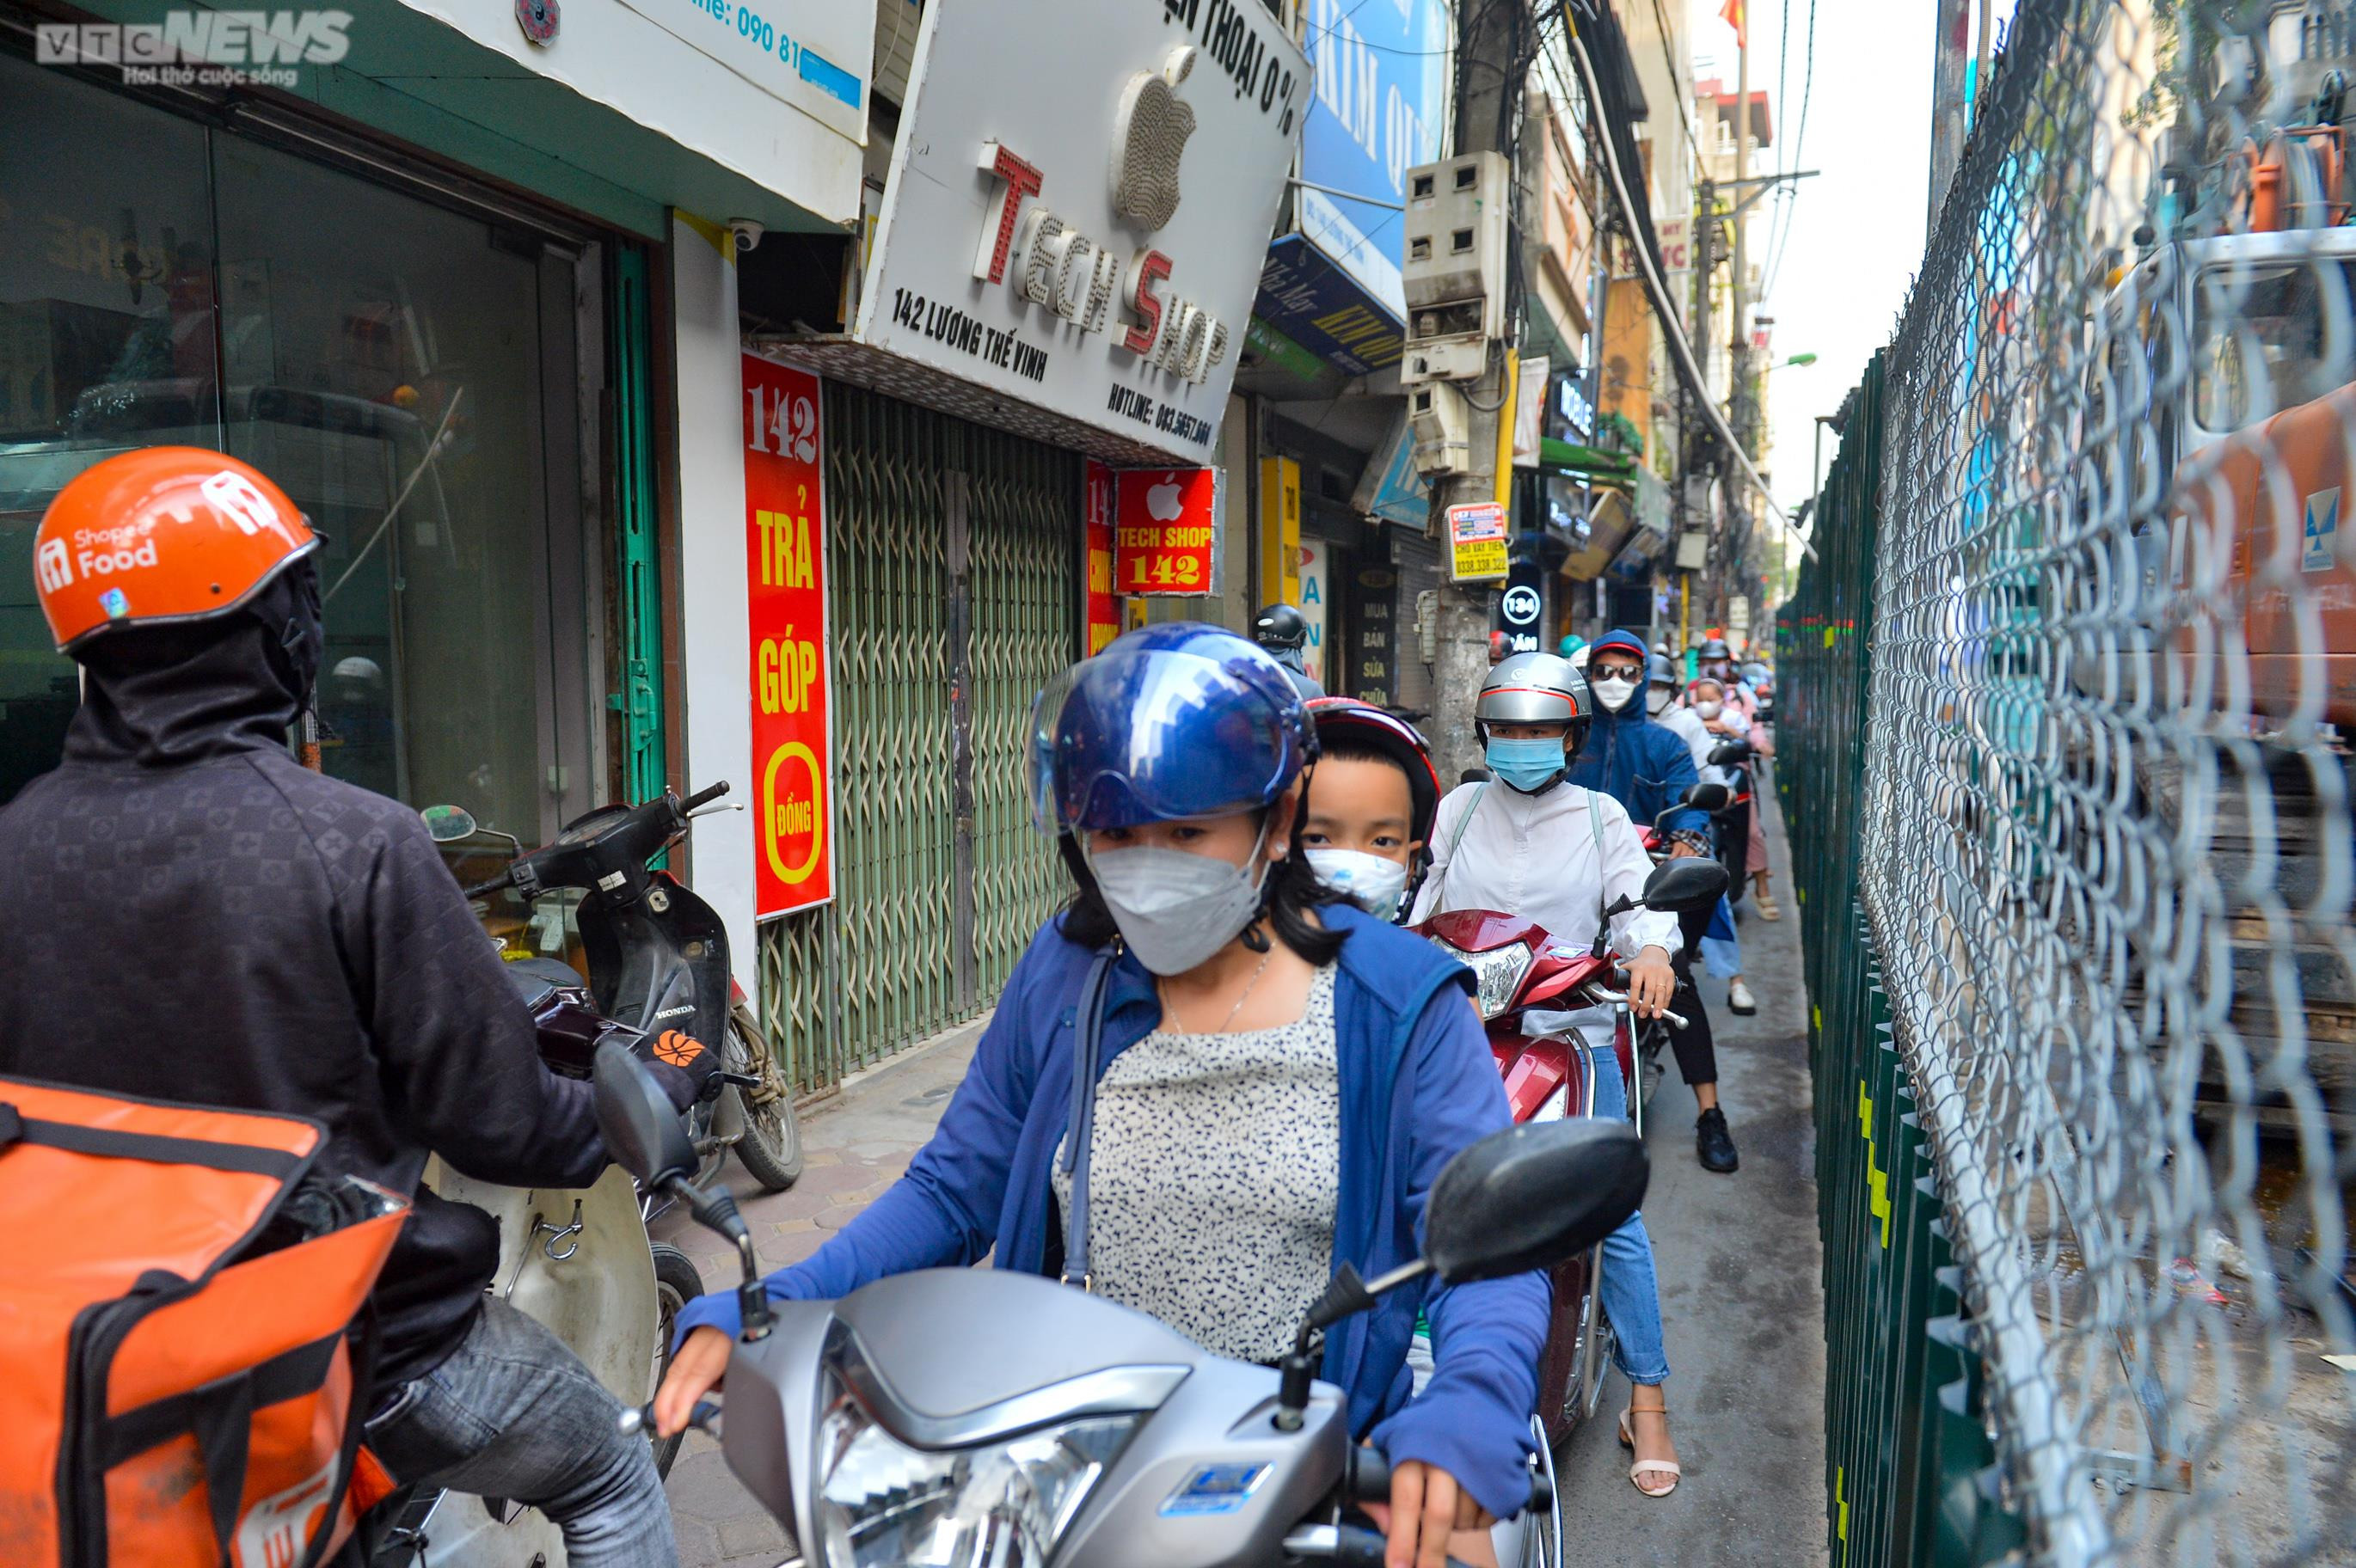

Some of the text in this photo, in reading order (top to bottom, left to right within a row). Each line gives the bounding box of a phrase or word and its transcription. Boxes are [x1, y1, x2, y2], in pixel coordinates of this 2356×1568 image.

[737, 7, 773, 52] 090
[1201, 0, 1265, 100] THOẠI
[1261, 57, 1279, 112] 0
[1277, 70, 1297, 136] %
[893, 287, 926, 331] 142
[984, 327, 1017, 368] THẾ
[1011, 341, 1049, 383] VINH
[1112, 249, 1228, 384] SHOP
[747, 383, 817, 464] 142
[1107, 383, 1153, 426] HOTLINE:
[74, 523, 151, 548] Shopee
[756, 484, 814, 590] TRẢ
[1120, 527, 1212, 548] TECH SHOP
[77, 538, 157, 579] Food
[1129, 554, 1200, 585] 142
[1364, 603, 1389, 619] MUA
[759, 624, 817, 715] GÓP
[776, 792, 812, 837] ĐỒNG
[655, 1004, 696, 1020] HONDA
